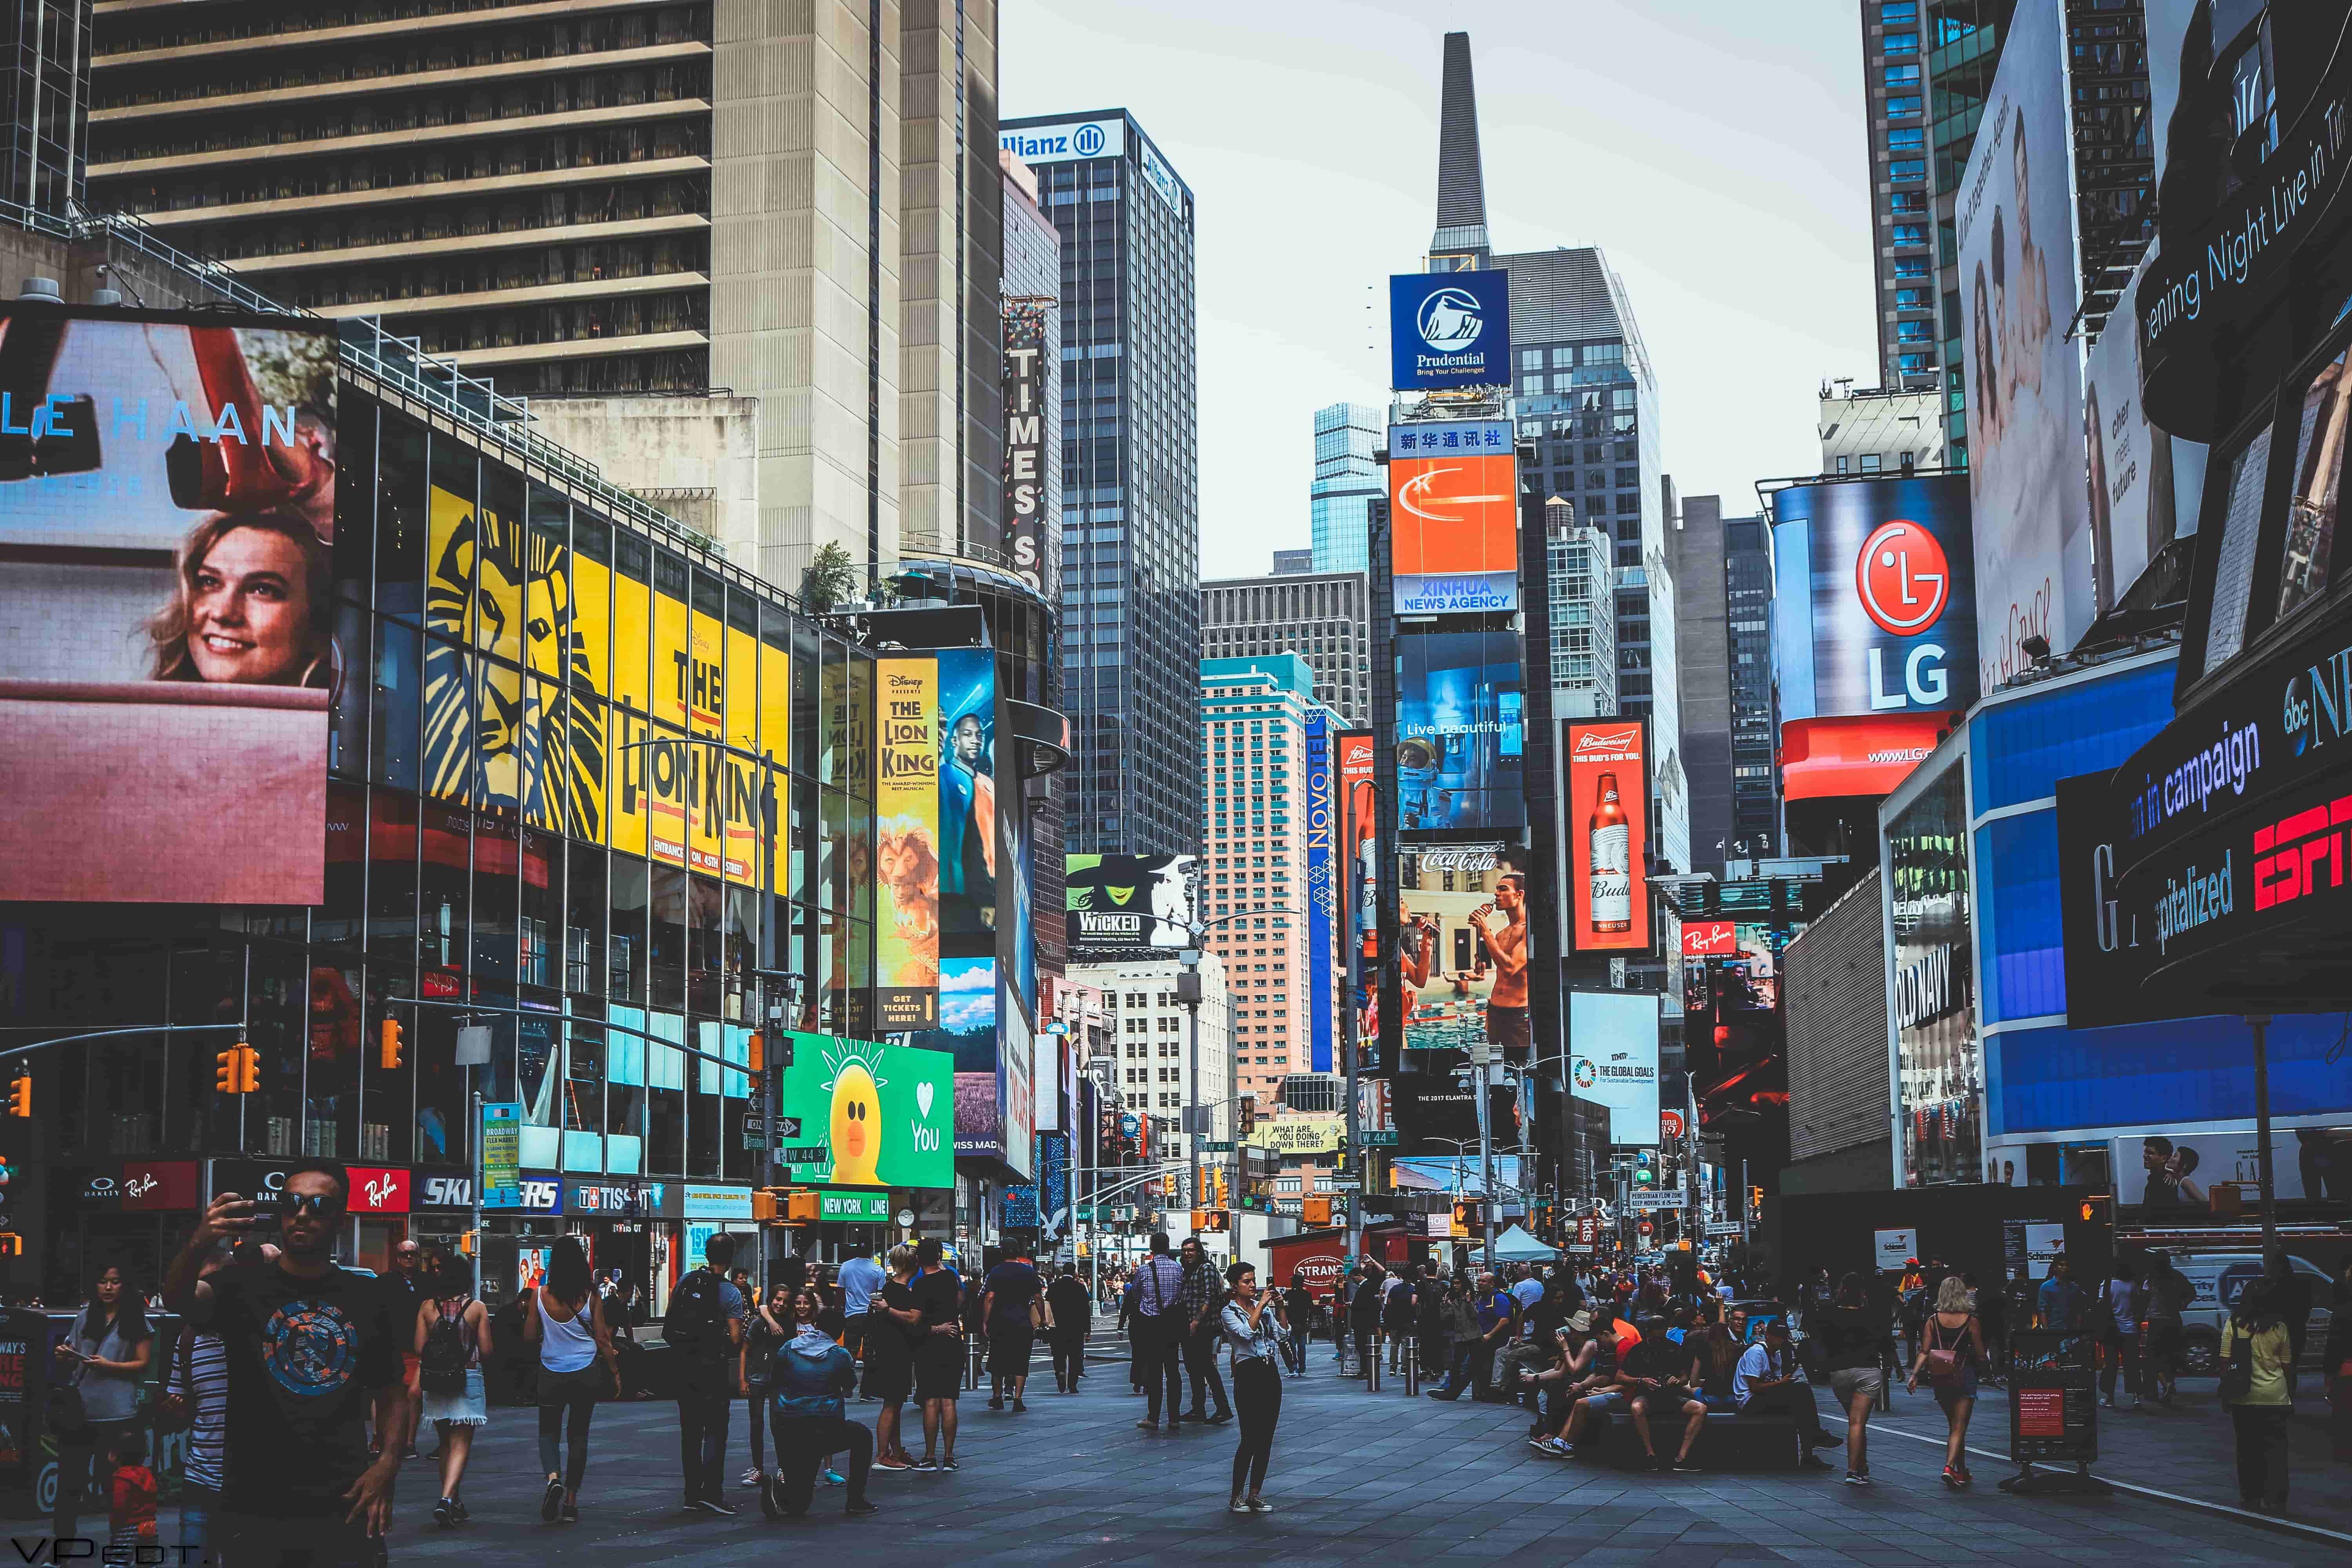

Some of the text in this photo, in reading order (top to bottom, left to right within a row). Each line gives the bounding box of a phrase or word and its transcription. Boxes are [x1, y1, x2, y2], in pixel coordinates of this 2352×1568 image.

[1001, 135, 1067, 156] llianz
[1147, 154, 1169, 196] Allianz
[2208, 207, 2269, 291] Night
[2272, 169, 2307, 234] Live
[2310, 140, 2325, 189] in
[1417, 352, 1485, 367] Prudential
[1417, 368, 1434, 377] Bring
[112, 397, 296, 448] HAAN
[1009, 348, 1039, 515] TIMES
[1400, 430, 1501, 450] 新华通讯社
[2112, 460, 2136, 508] future
[1419, 580, 1493, 597] XINHUA
[1404, 595, 1509, 610] NEWS AGENCY
[673, 649, 721, 715] THE
[1868, 643, 1949, 711] LG
[890, 701, 921, 716] THE
[885, 720, 928, 746] LION
[1407, 721, 1507, 735] Live beautiful
[1581, 737, 1631, 747] Budweiser
[622, 695, 699, 814] LION
[881, 748, 935, 779] KING
[1589, 754, 1610, 762] BUD'S
[1625, 752, 1641, 760] YOU.
[2165, 720, 2261, 813] campaign
[1308, 721, 1328, 849] NOVOTEL
[654, 840, 743, 875] ENTRANCE ON 45TH STREET
[2154, 849, 2234, 956] pitalized
[1078, 912, 1140, 931] WICKED
[1894, 942, 1951, 1031] OLD NAVY
[1599, 1065, 1654, 1077] THE GLOBAL GOALS
[486, 1127, 518, 1136] BROADWAY
[1296, 1132, 1320, 1140] DOING
[1363, 1132, 1370, 1143] W
[1374, 1132, 1387, 1143] 44
[1209, 1143, 1214, 1151] W
[1296, 1140, 1324, 1148] THERE?
[789, 1150, 797, 1161] W
[802, 1149, 814, 1161] 44
[789, 1163, 803, 1174] ALLY
[2236, 1161, 2256, 1181] GA
[257, 1192, 278, 1201] OAK
[824, 1198, 886, 1214] NEW YORK LINE
[1428, 1217, 1446, 1225] HOP
[1582, 1218, 1593, 1242] tkts
[0, 1342, 25, 1354] WAY'S
